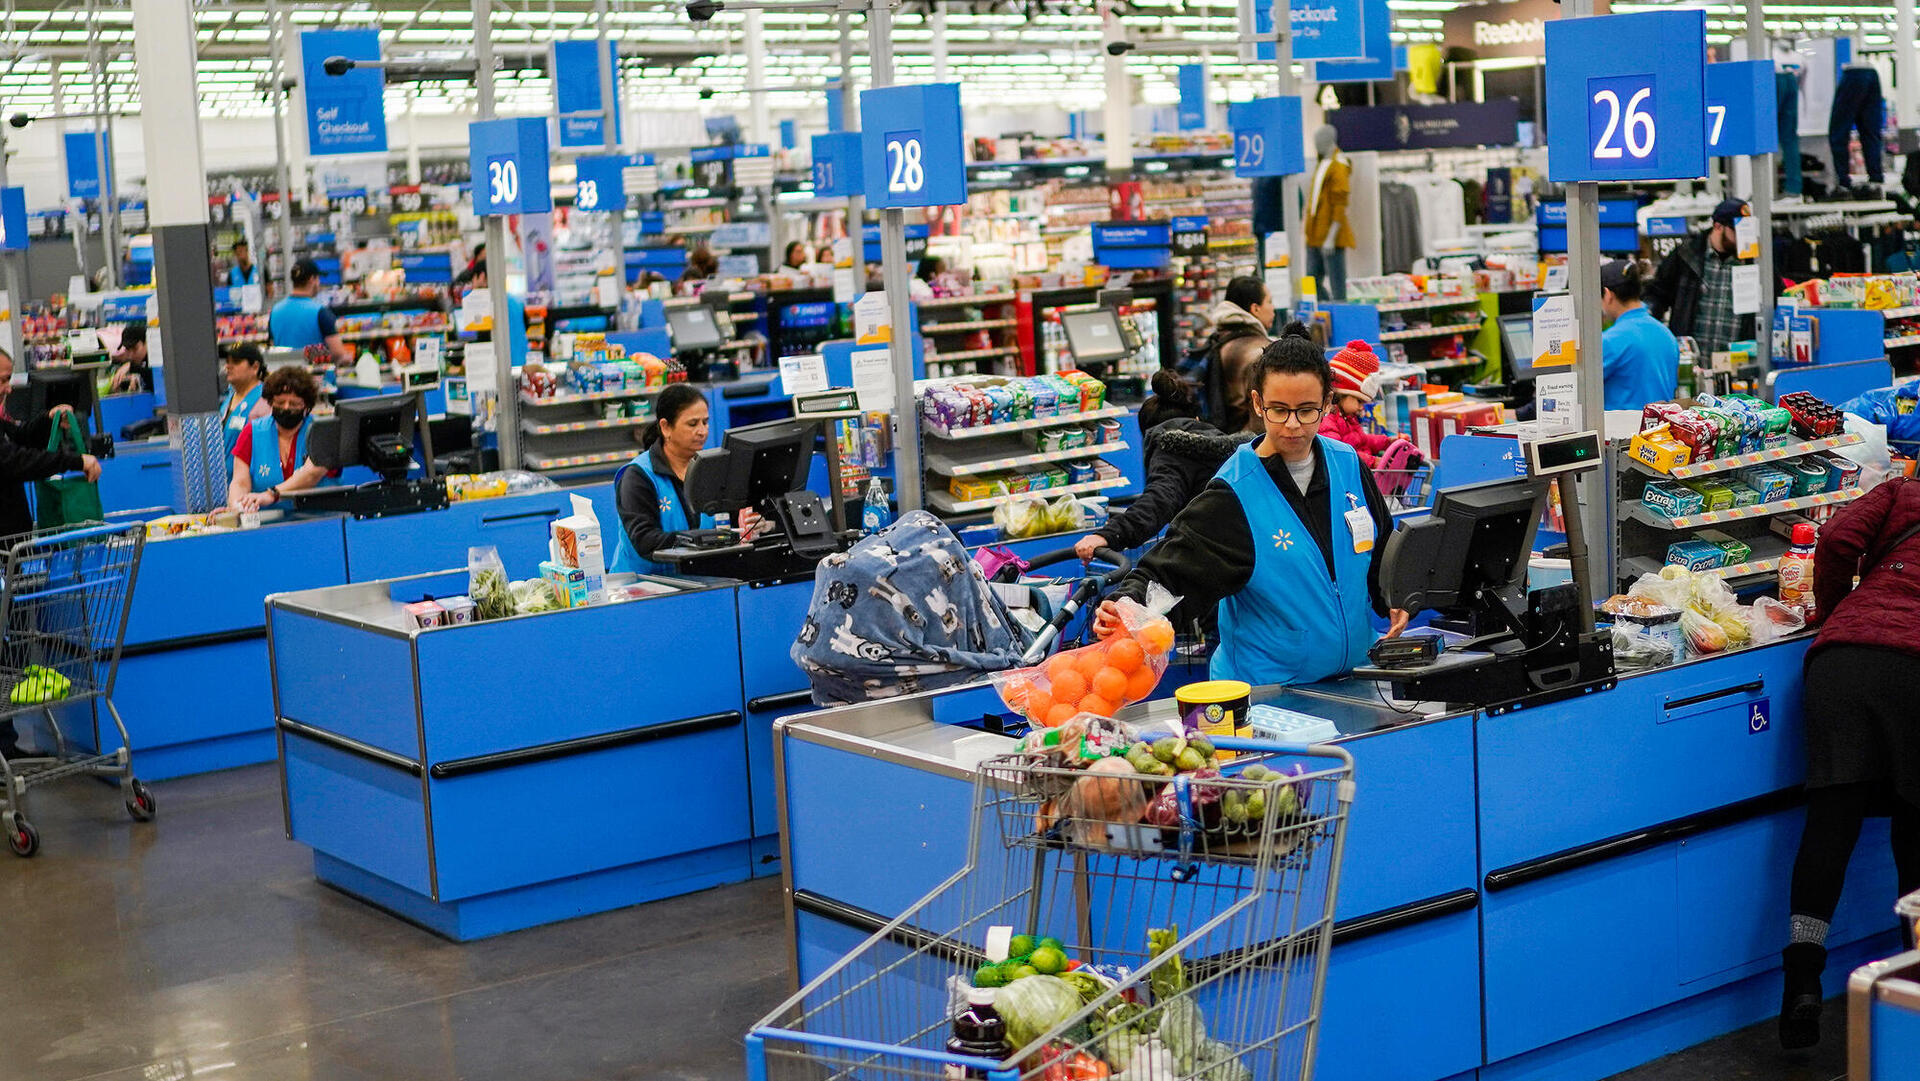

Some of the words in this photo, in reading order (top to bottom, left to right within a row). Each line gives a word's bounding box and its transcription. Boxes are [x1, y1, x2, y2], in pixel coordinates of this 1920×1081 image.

[1269, 5, 1337, 22] Ceckout
[317, 107, 339, 120] Self
[319, 121, 369, 135] Checkout
[1593, 88, 1656, 159] 26
[1707, 105, 1727, 146] 7
[1238, 134, 1264, 167] 29
[886, 138, 924, 193] 28
[489, 160, 518, 204] 30
[815, 162, 834, 190] 31
[1639, 451, 1656, 464] Fruit
[1640, 444, 1657, 457] Juicy
[1644, 490, 1670, 504] Extra
[1669, 553, 1688, 565] Extra
[1691, 557, 1715, 572] Extra
[1780, 567, 1800, 578] Coffee
